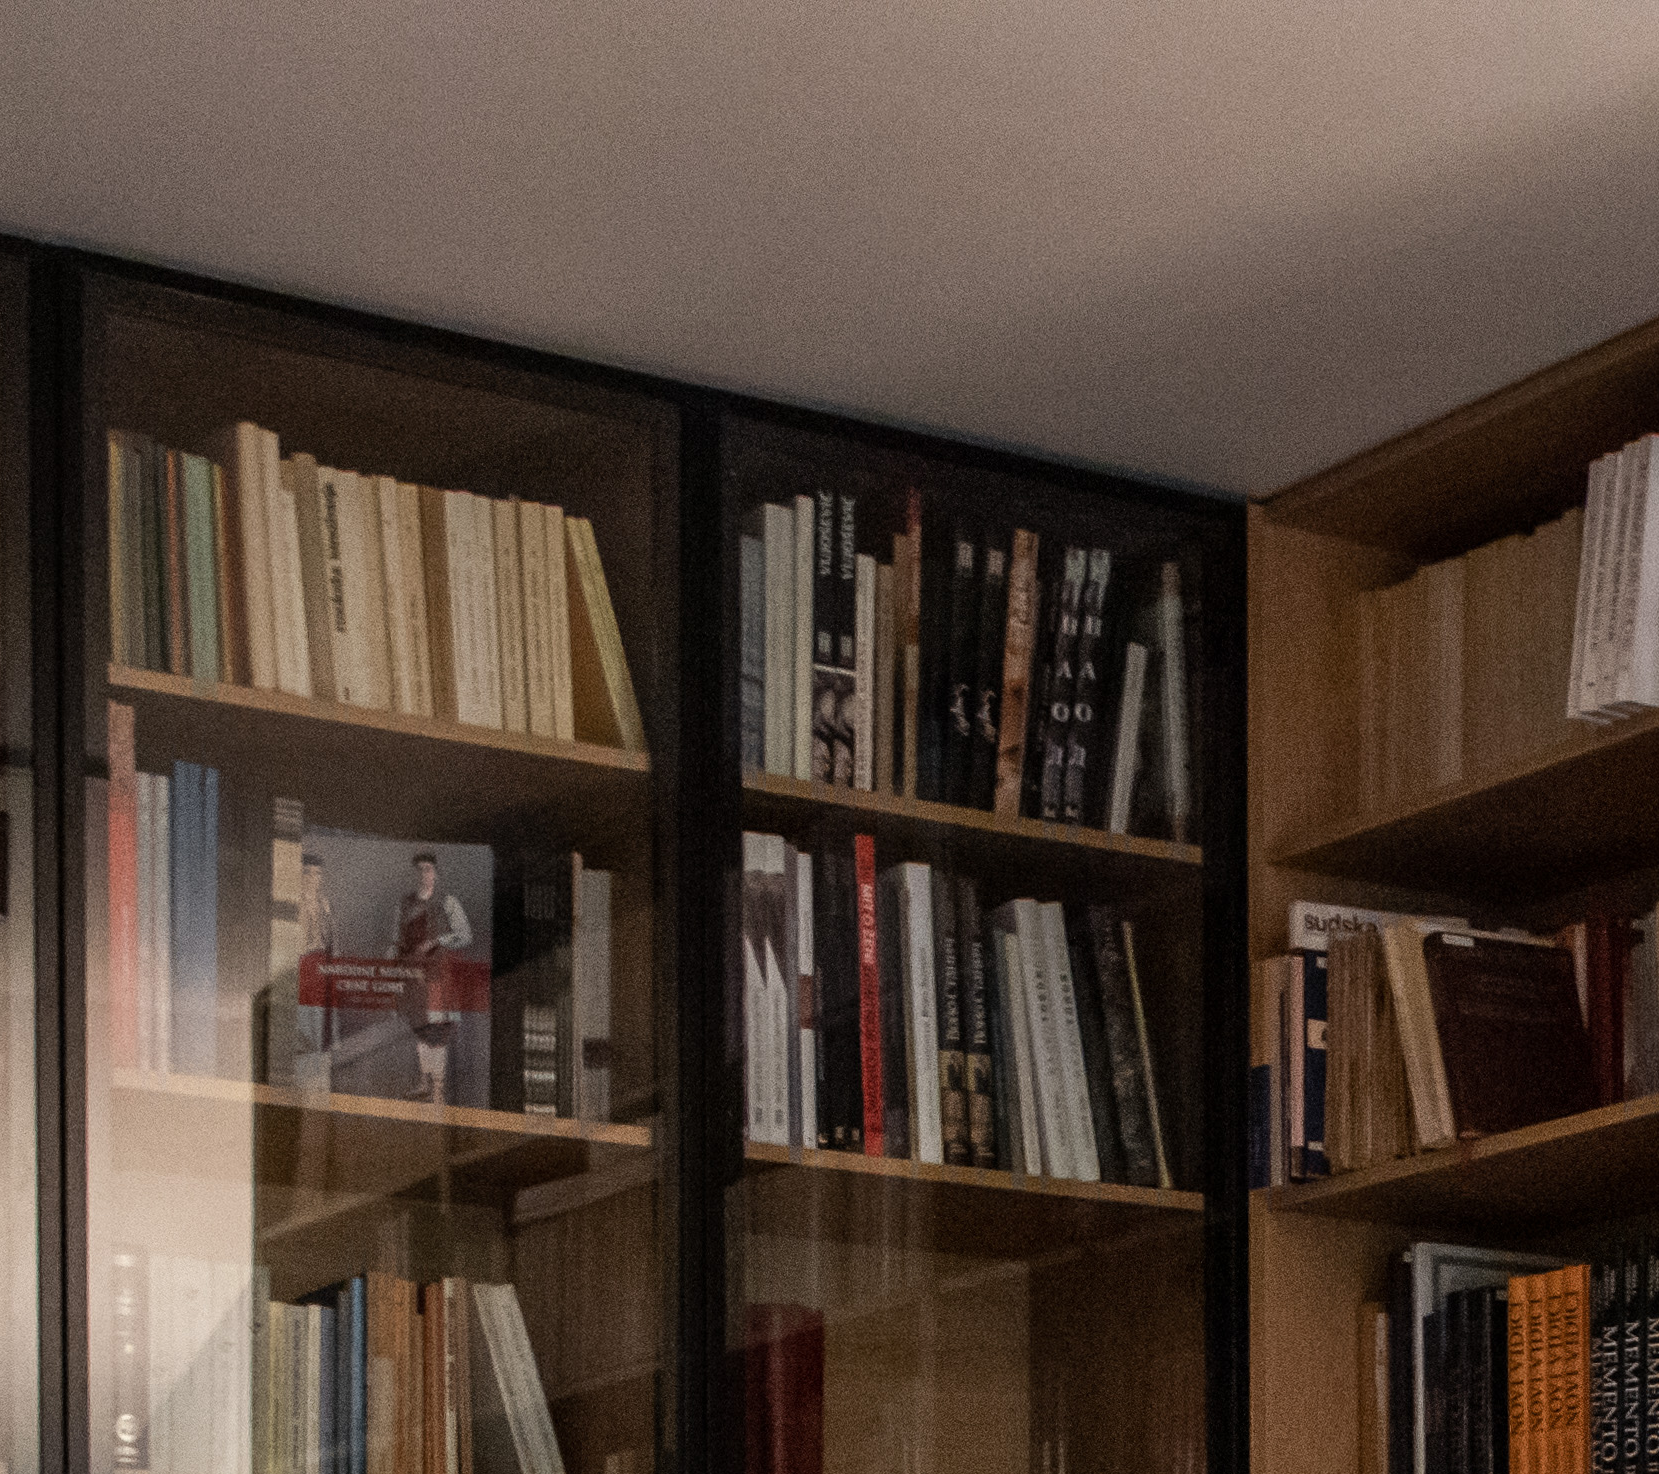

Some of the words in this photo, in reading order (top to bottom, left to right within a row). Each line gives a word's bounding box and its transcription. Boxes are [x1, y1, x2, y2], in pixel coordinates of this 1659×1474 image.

[1510, 1380, 1524, 1435] NOVI
[1529, 1378, 1543, 1433] NOVI
[1547, 1374, 1563, 1431] NOVI
[1563, 1371, 1579, 1427] NOVI
[1602, 1324, 1619, 1463] MEMENTO
[1623, 1319, 1641, 1459] MEMENTO
